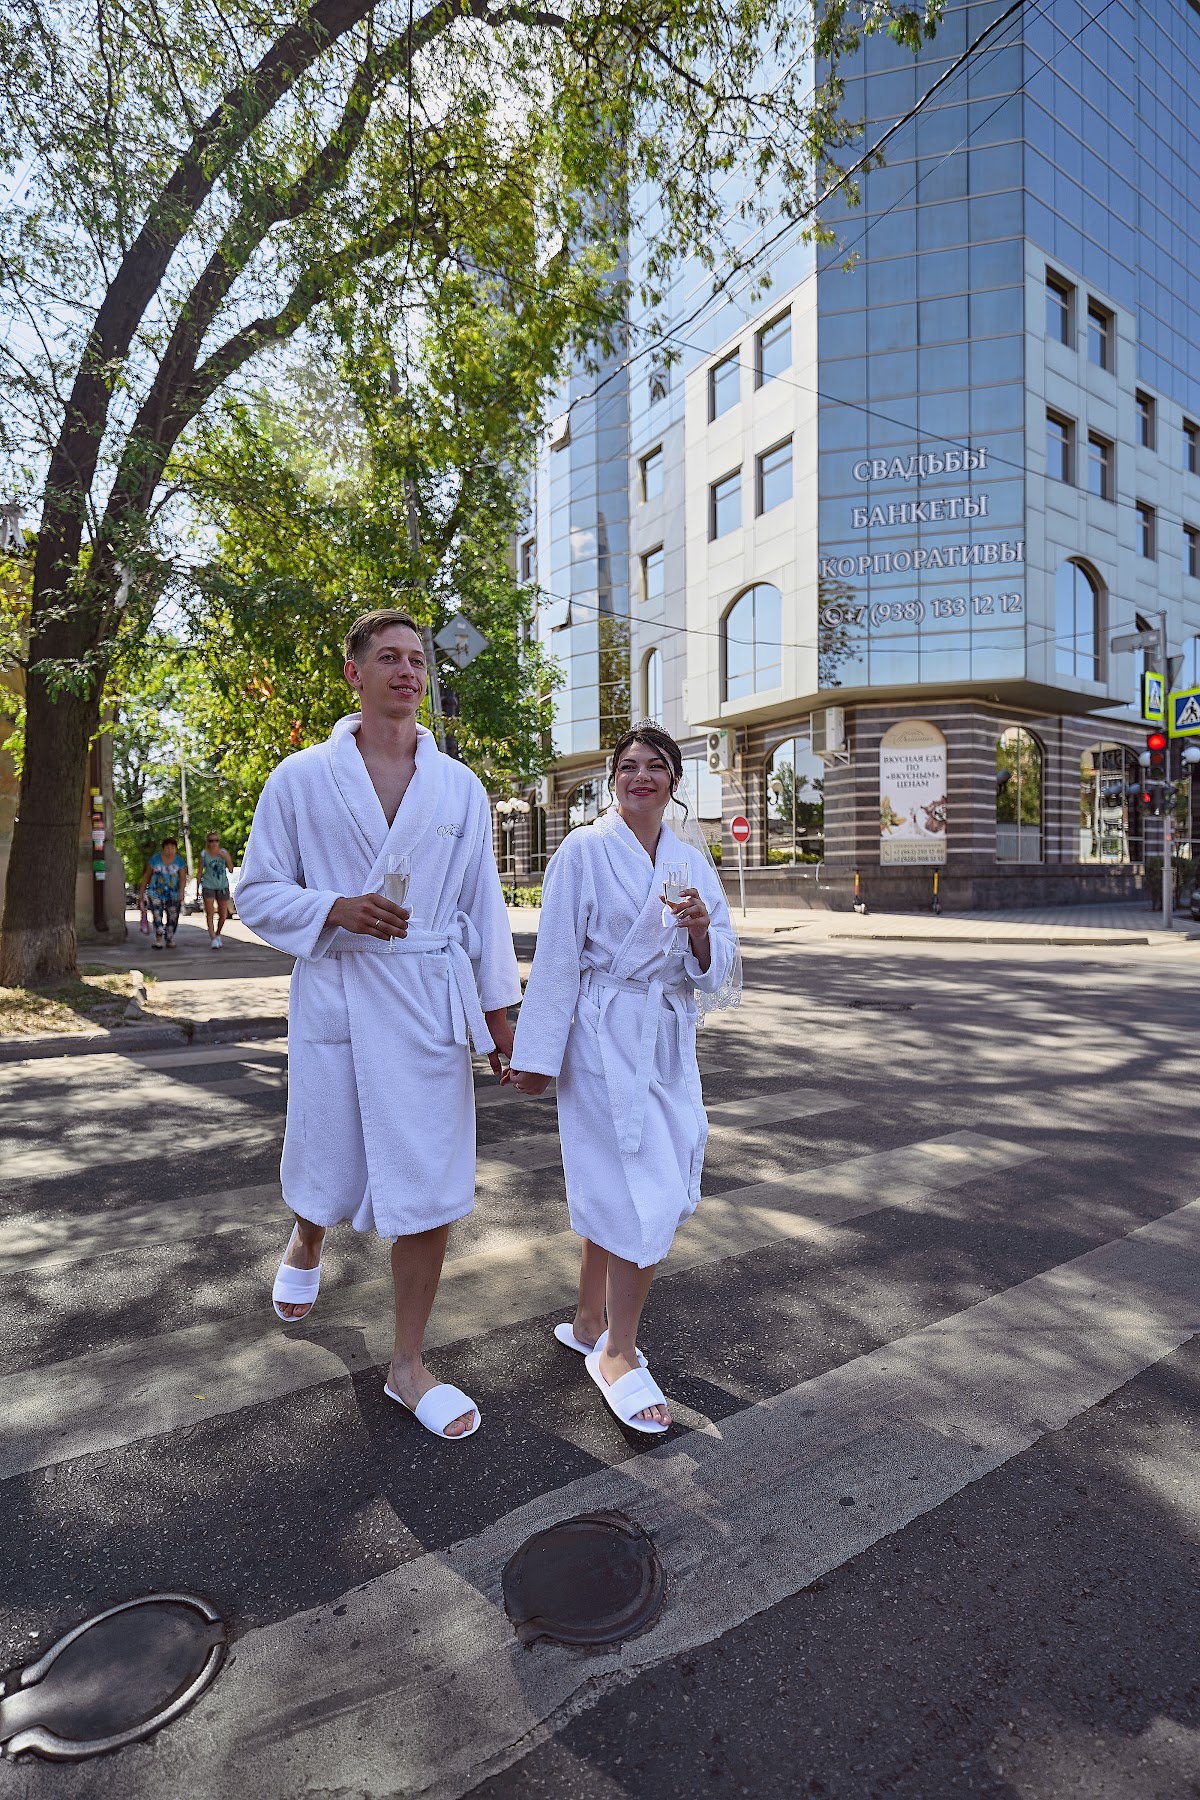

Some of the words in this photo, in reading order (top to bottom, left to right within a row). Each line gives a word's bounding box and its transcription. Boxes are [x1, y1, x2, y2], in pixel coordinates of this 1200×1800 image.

[853, 448, 988, 481] СВАДЬБЫ
[852, 494, 988, 528] БАНКЕТЫ
[820, 541, 1025, 578] КОРПОРАТИВЫ
[870, 600, 925, 628] (938)
[931, 597, 966, 618] 133
[971, 594, 994, 615] 12
[999, 592, 1022, 614] 12
[884, 755, 923, 763] ВКУСНАЯ
